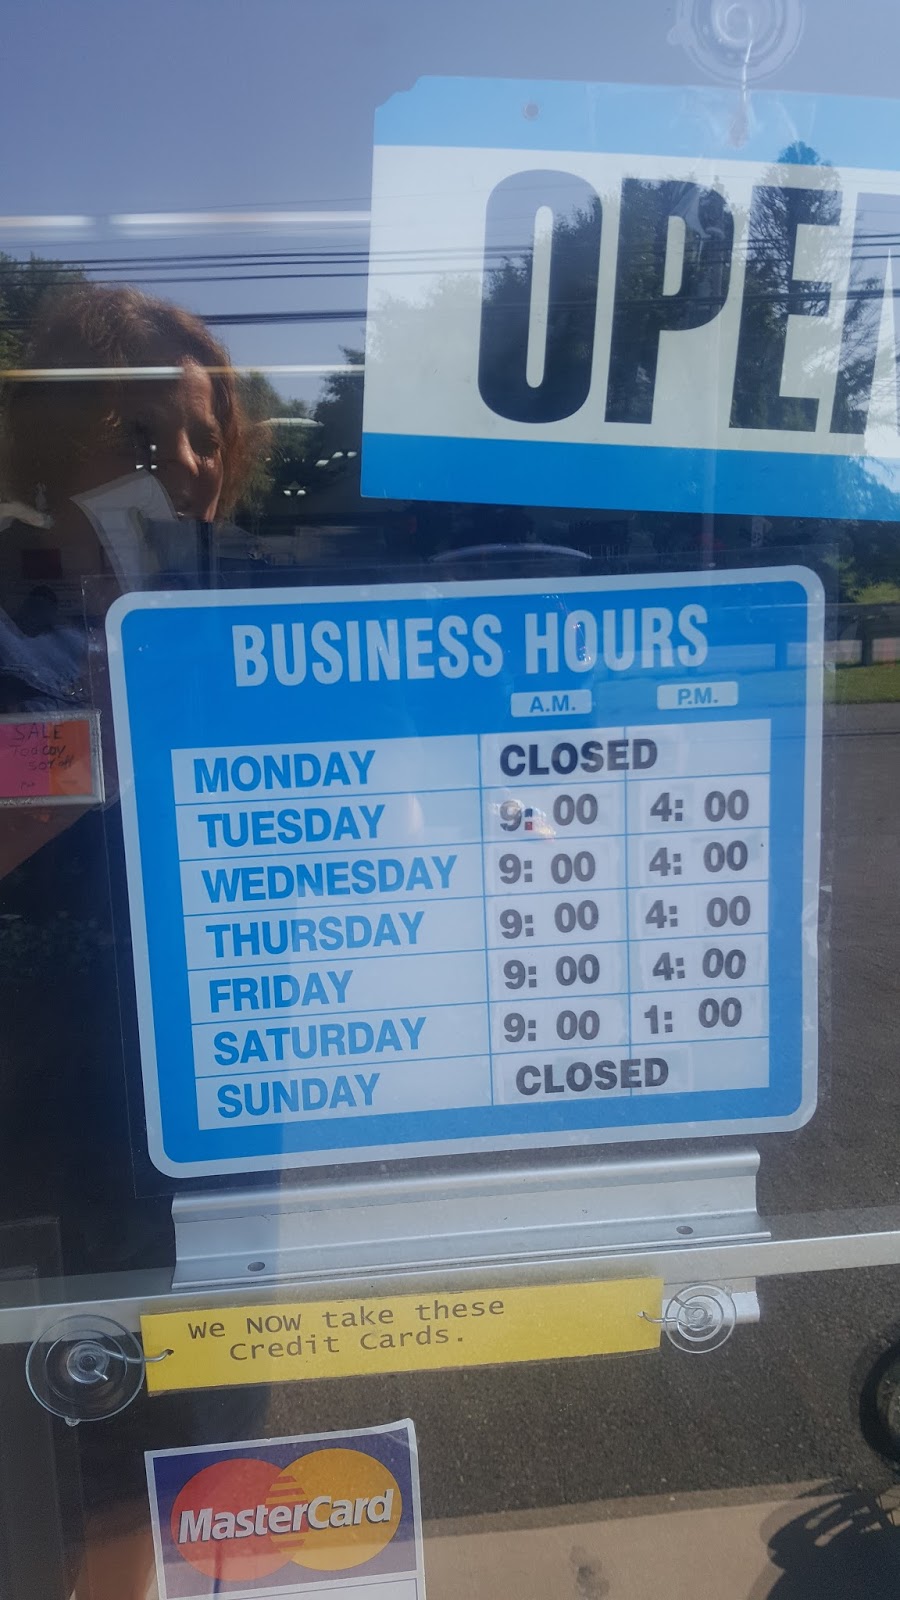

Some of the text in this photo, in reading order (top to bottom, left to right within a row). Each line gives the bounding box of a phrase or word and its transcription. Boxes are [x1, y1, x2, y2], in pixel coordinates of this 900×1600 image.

[231, 603, 710, 687] BUSINESS HOURS
[529, 687, 720, 713] A.M. P.M.
[15, 722, 64, 741] SALE
[193, 738, 658, 794] MONDAY CLOSED
[198, 804, 386, 848] TUESDAY
[201, 855, 458, 904] WEDNESDAY
[205, 911, 425, 958] THURSDAY
[209, 970, 353, 1013] FRIDAY
[213, 1017, 427, 1066] SATURDAY
[217, 1057, 669, 1118] SUNDAY CLOSED
[187, 1300, 505, 1340] We NOW take these
[229, 1325, 464, 1361] Credit Cards.
[178, 1488, 394, 1544] MasterCard
